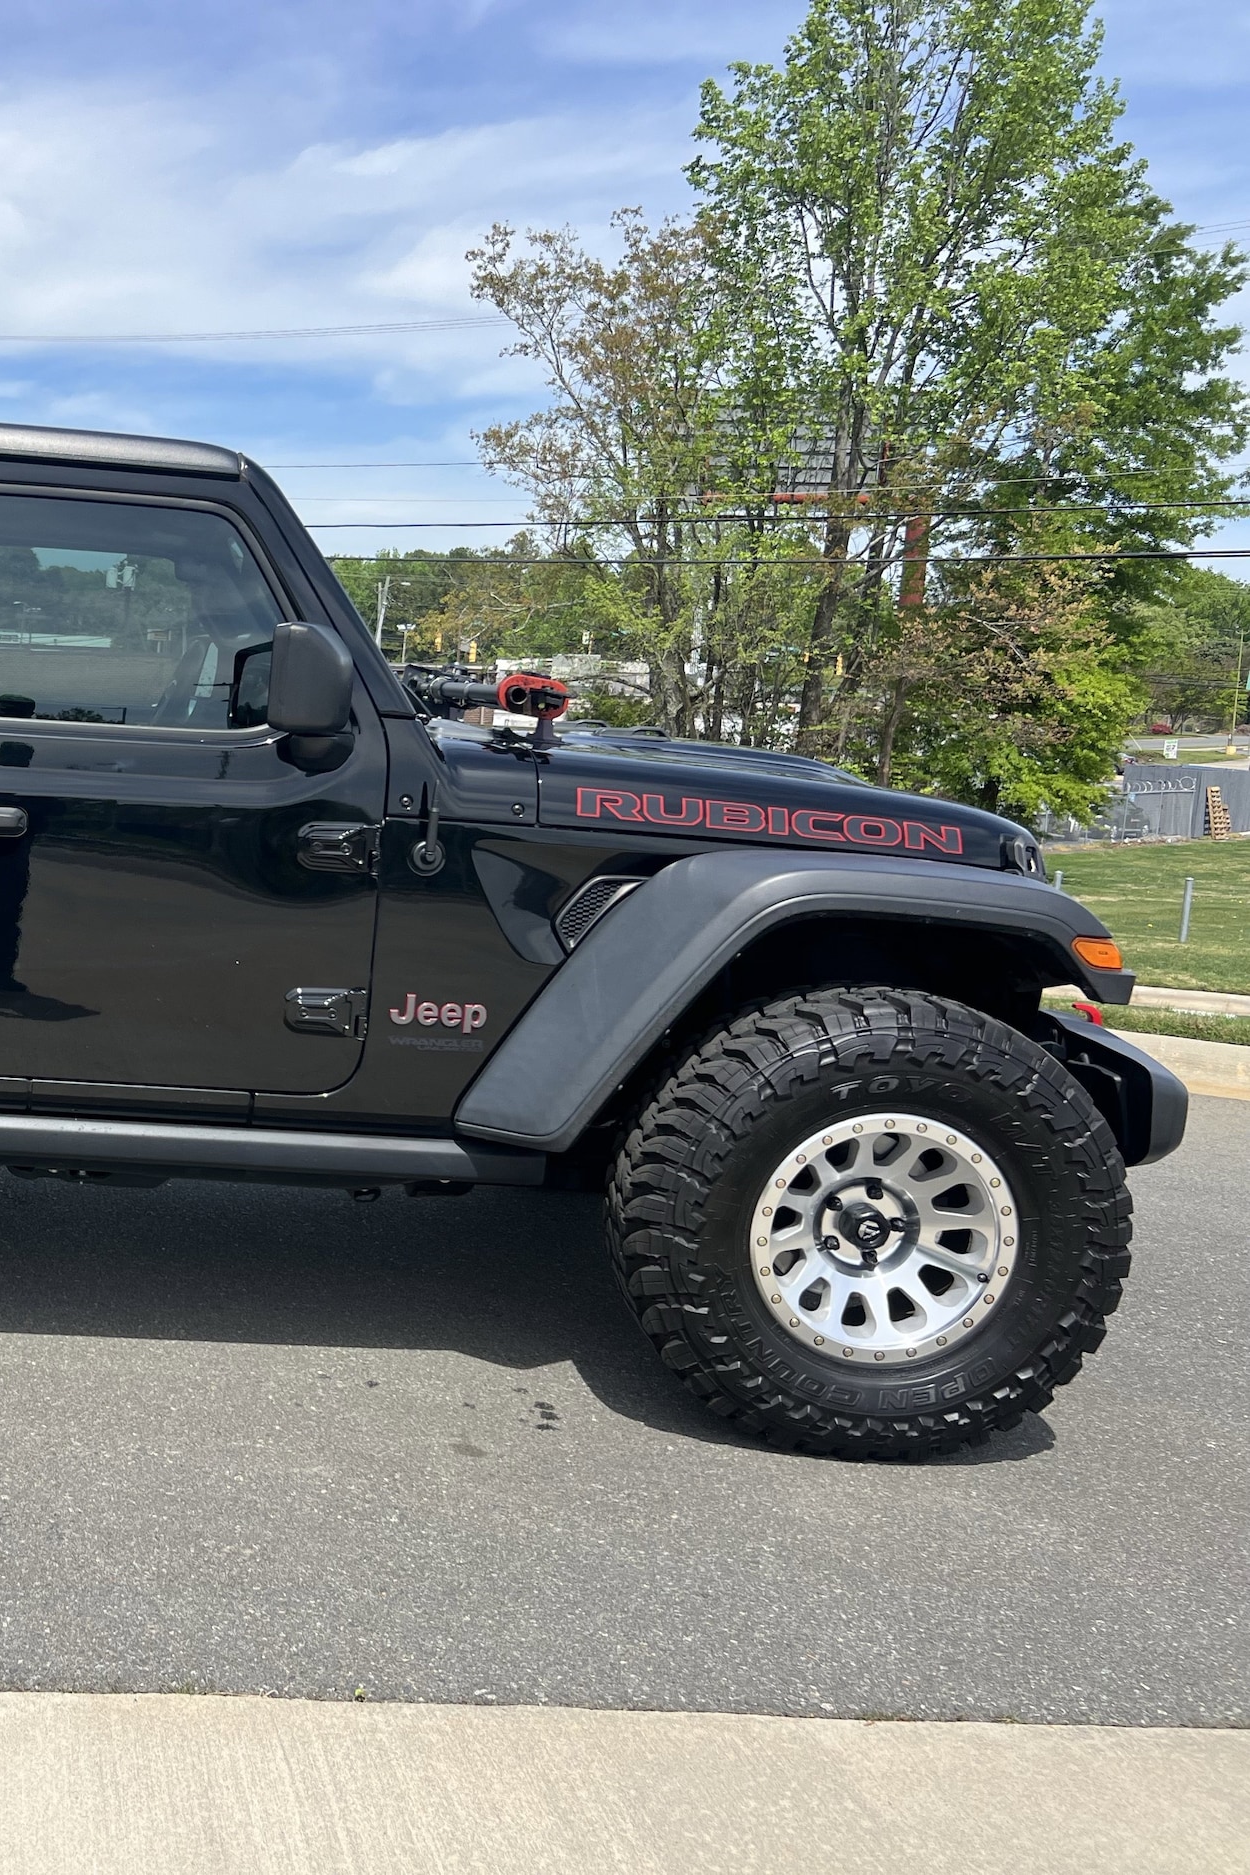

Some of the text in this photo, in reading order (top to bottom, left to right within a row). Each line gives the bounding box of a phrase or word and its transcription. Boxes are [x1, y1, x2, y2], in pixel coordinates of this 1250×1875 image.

[577, 787, 963, 855] RUBICON
[389, 993, 487, 1034] Jeep
[389, 1036, 483, 1049] WRANGLER
[829, 1074, 973, 1102] TOYO
[717, 1264, 996, 1410] OPEN COUNTRY
